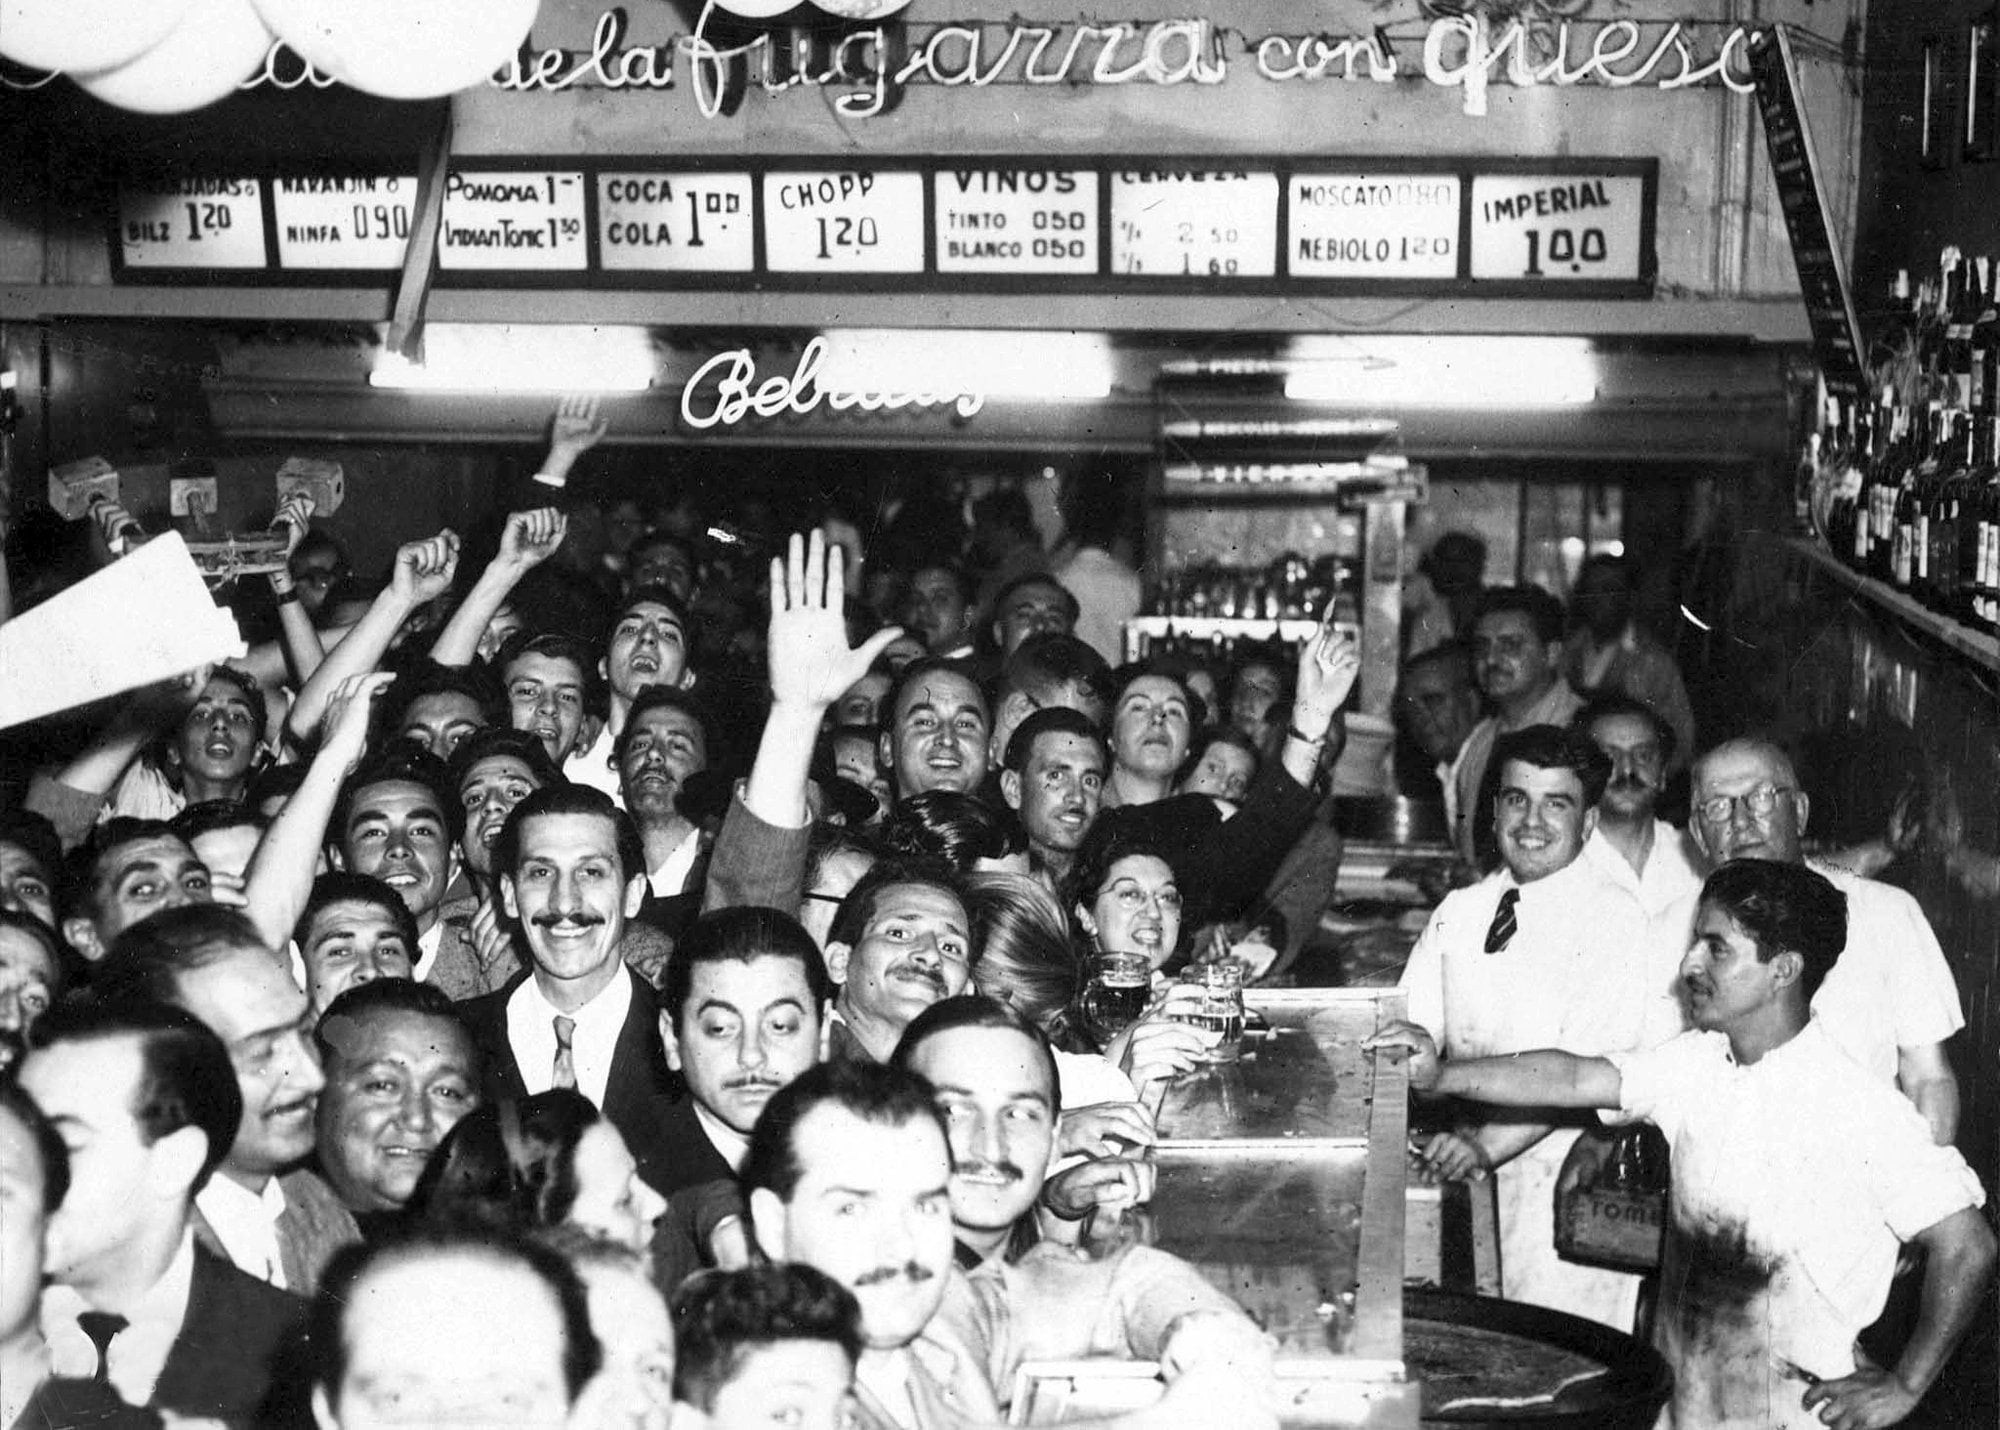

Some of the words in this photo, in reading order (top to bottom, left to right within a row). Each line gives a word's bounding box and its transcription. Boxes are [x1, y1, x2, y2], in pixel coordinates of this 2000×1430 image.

[1257, 32, 1397, 82] con
[607, 178, 673, 203] COCA
[780, 171, 875, 209] CHOPP
[955, 171, 1077, 194] VINOS
[1299, 184, 1392, 207] MOSCATO
[1484, 179, 1611, 223] IMPERIAL
[948, 211, 1007, 230] TINTO
[286, 225, 342, 242] NINFA
[607, 221, 673, 247] COLA
[948, 241, 1022, 259] BLANCO
[1299, 237, 1390, 261] NEBIOLO
